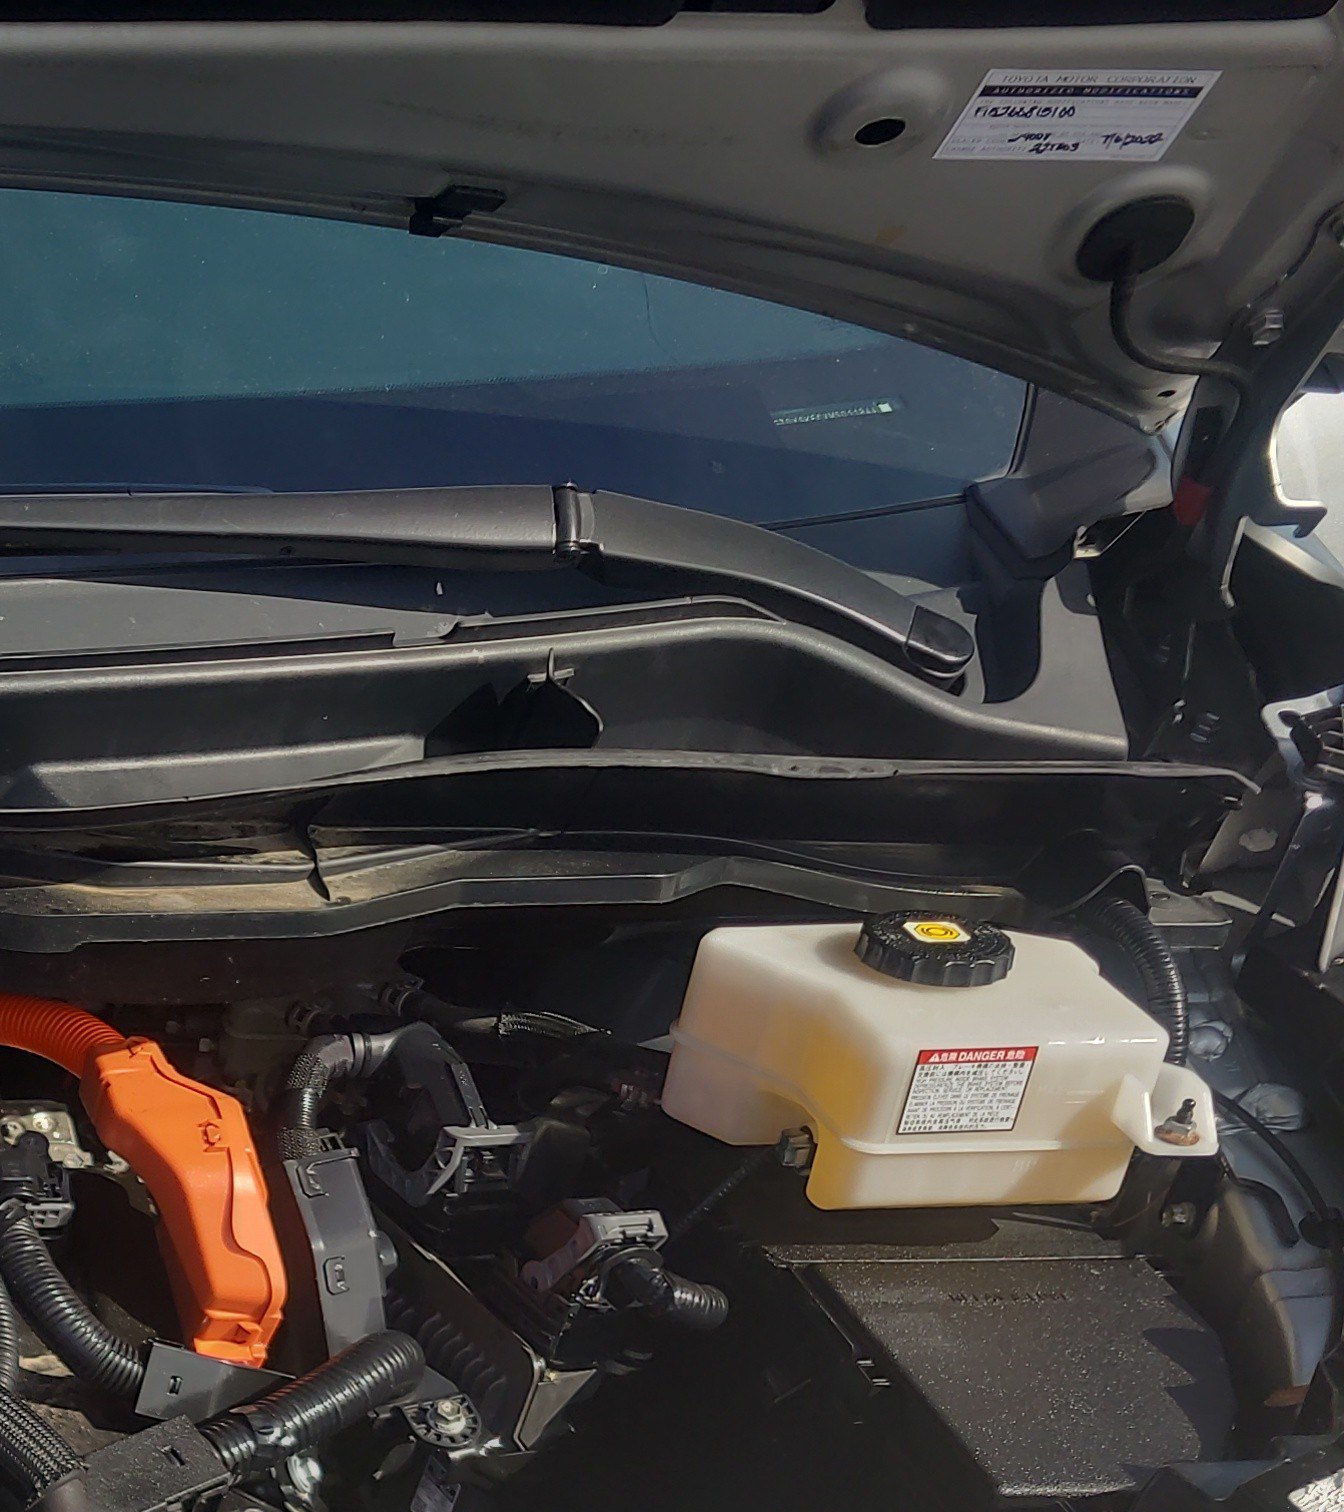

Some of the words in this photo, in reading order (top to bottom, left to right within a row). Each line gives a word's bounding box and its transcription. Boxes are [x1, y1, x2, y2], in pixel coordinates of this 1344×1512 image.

[1003, 75, 1048, 83] TOYOTA
[1056, 75, 1097, 83] MOTOR
[1107, 75, 1197, 84] CORPORATION
[958, 1050, 1006, 1061] DANGER
